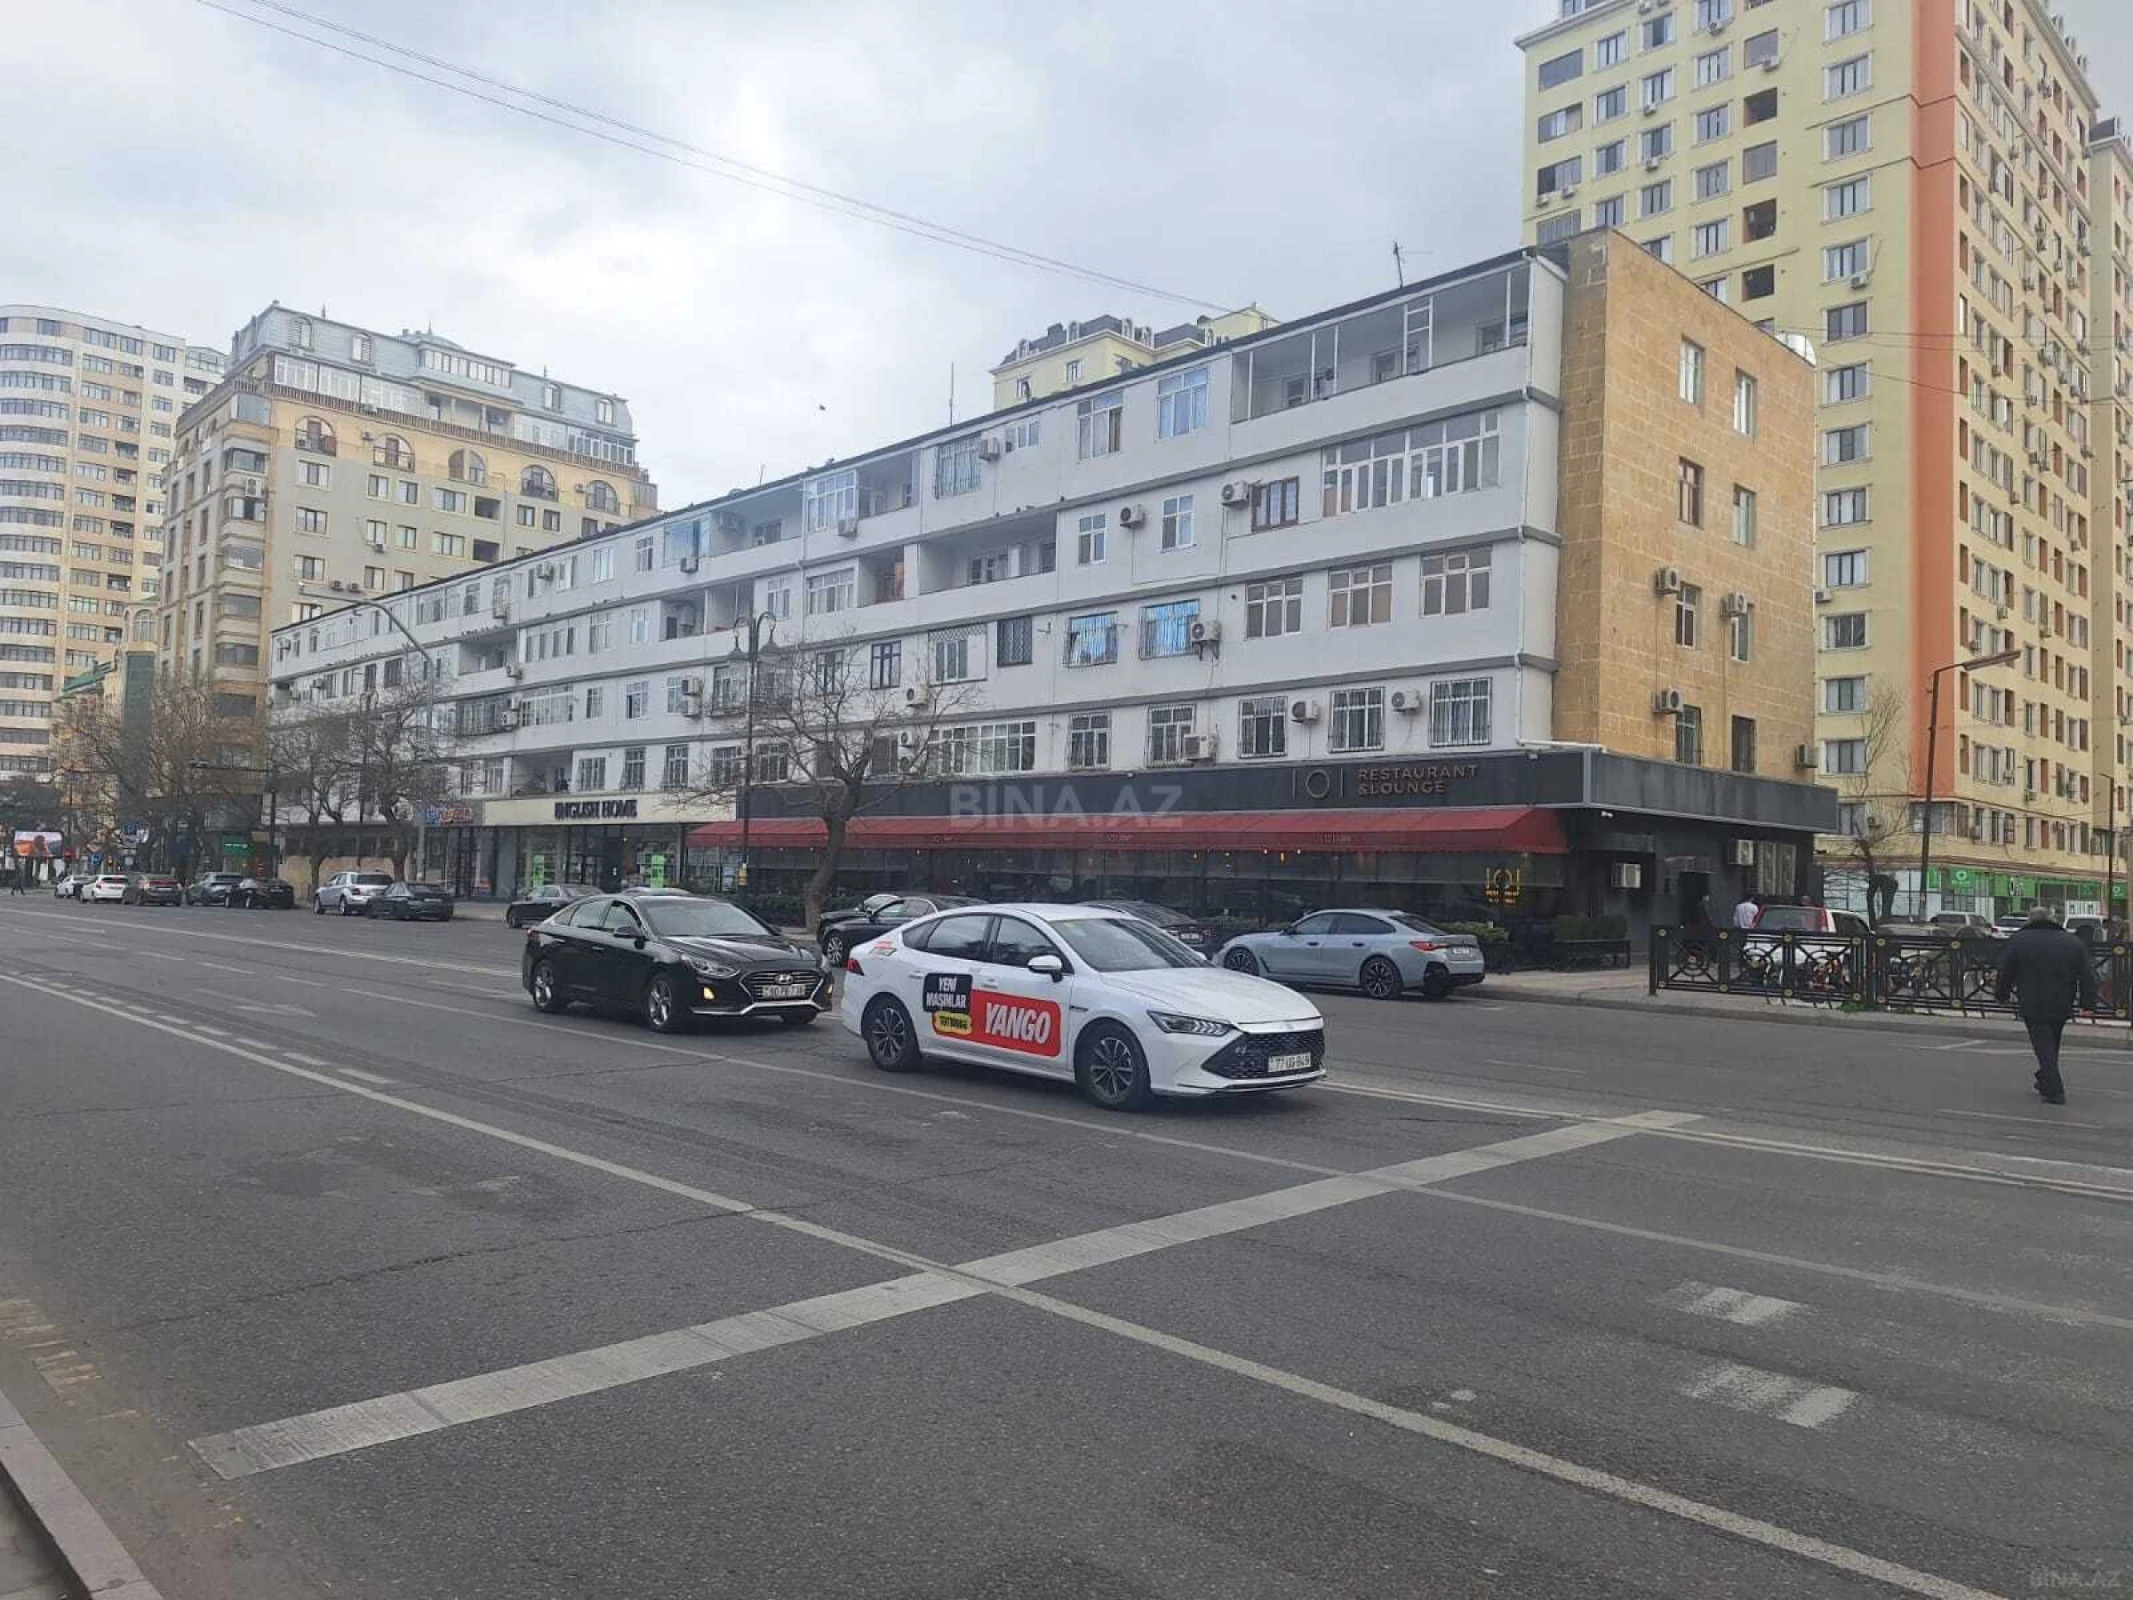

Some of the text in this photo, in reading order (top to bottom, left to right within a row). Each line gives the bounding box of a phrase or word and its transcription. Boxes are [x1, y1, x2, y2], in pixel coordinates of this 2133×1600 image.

[1357, 764, 1479, 781] RESTAURANT
[601, 800, 638, 818] HOME
[985, 1002, 1052, 1045] YANGO
